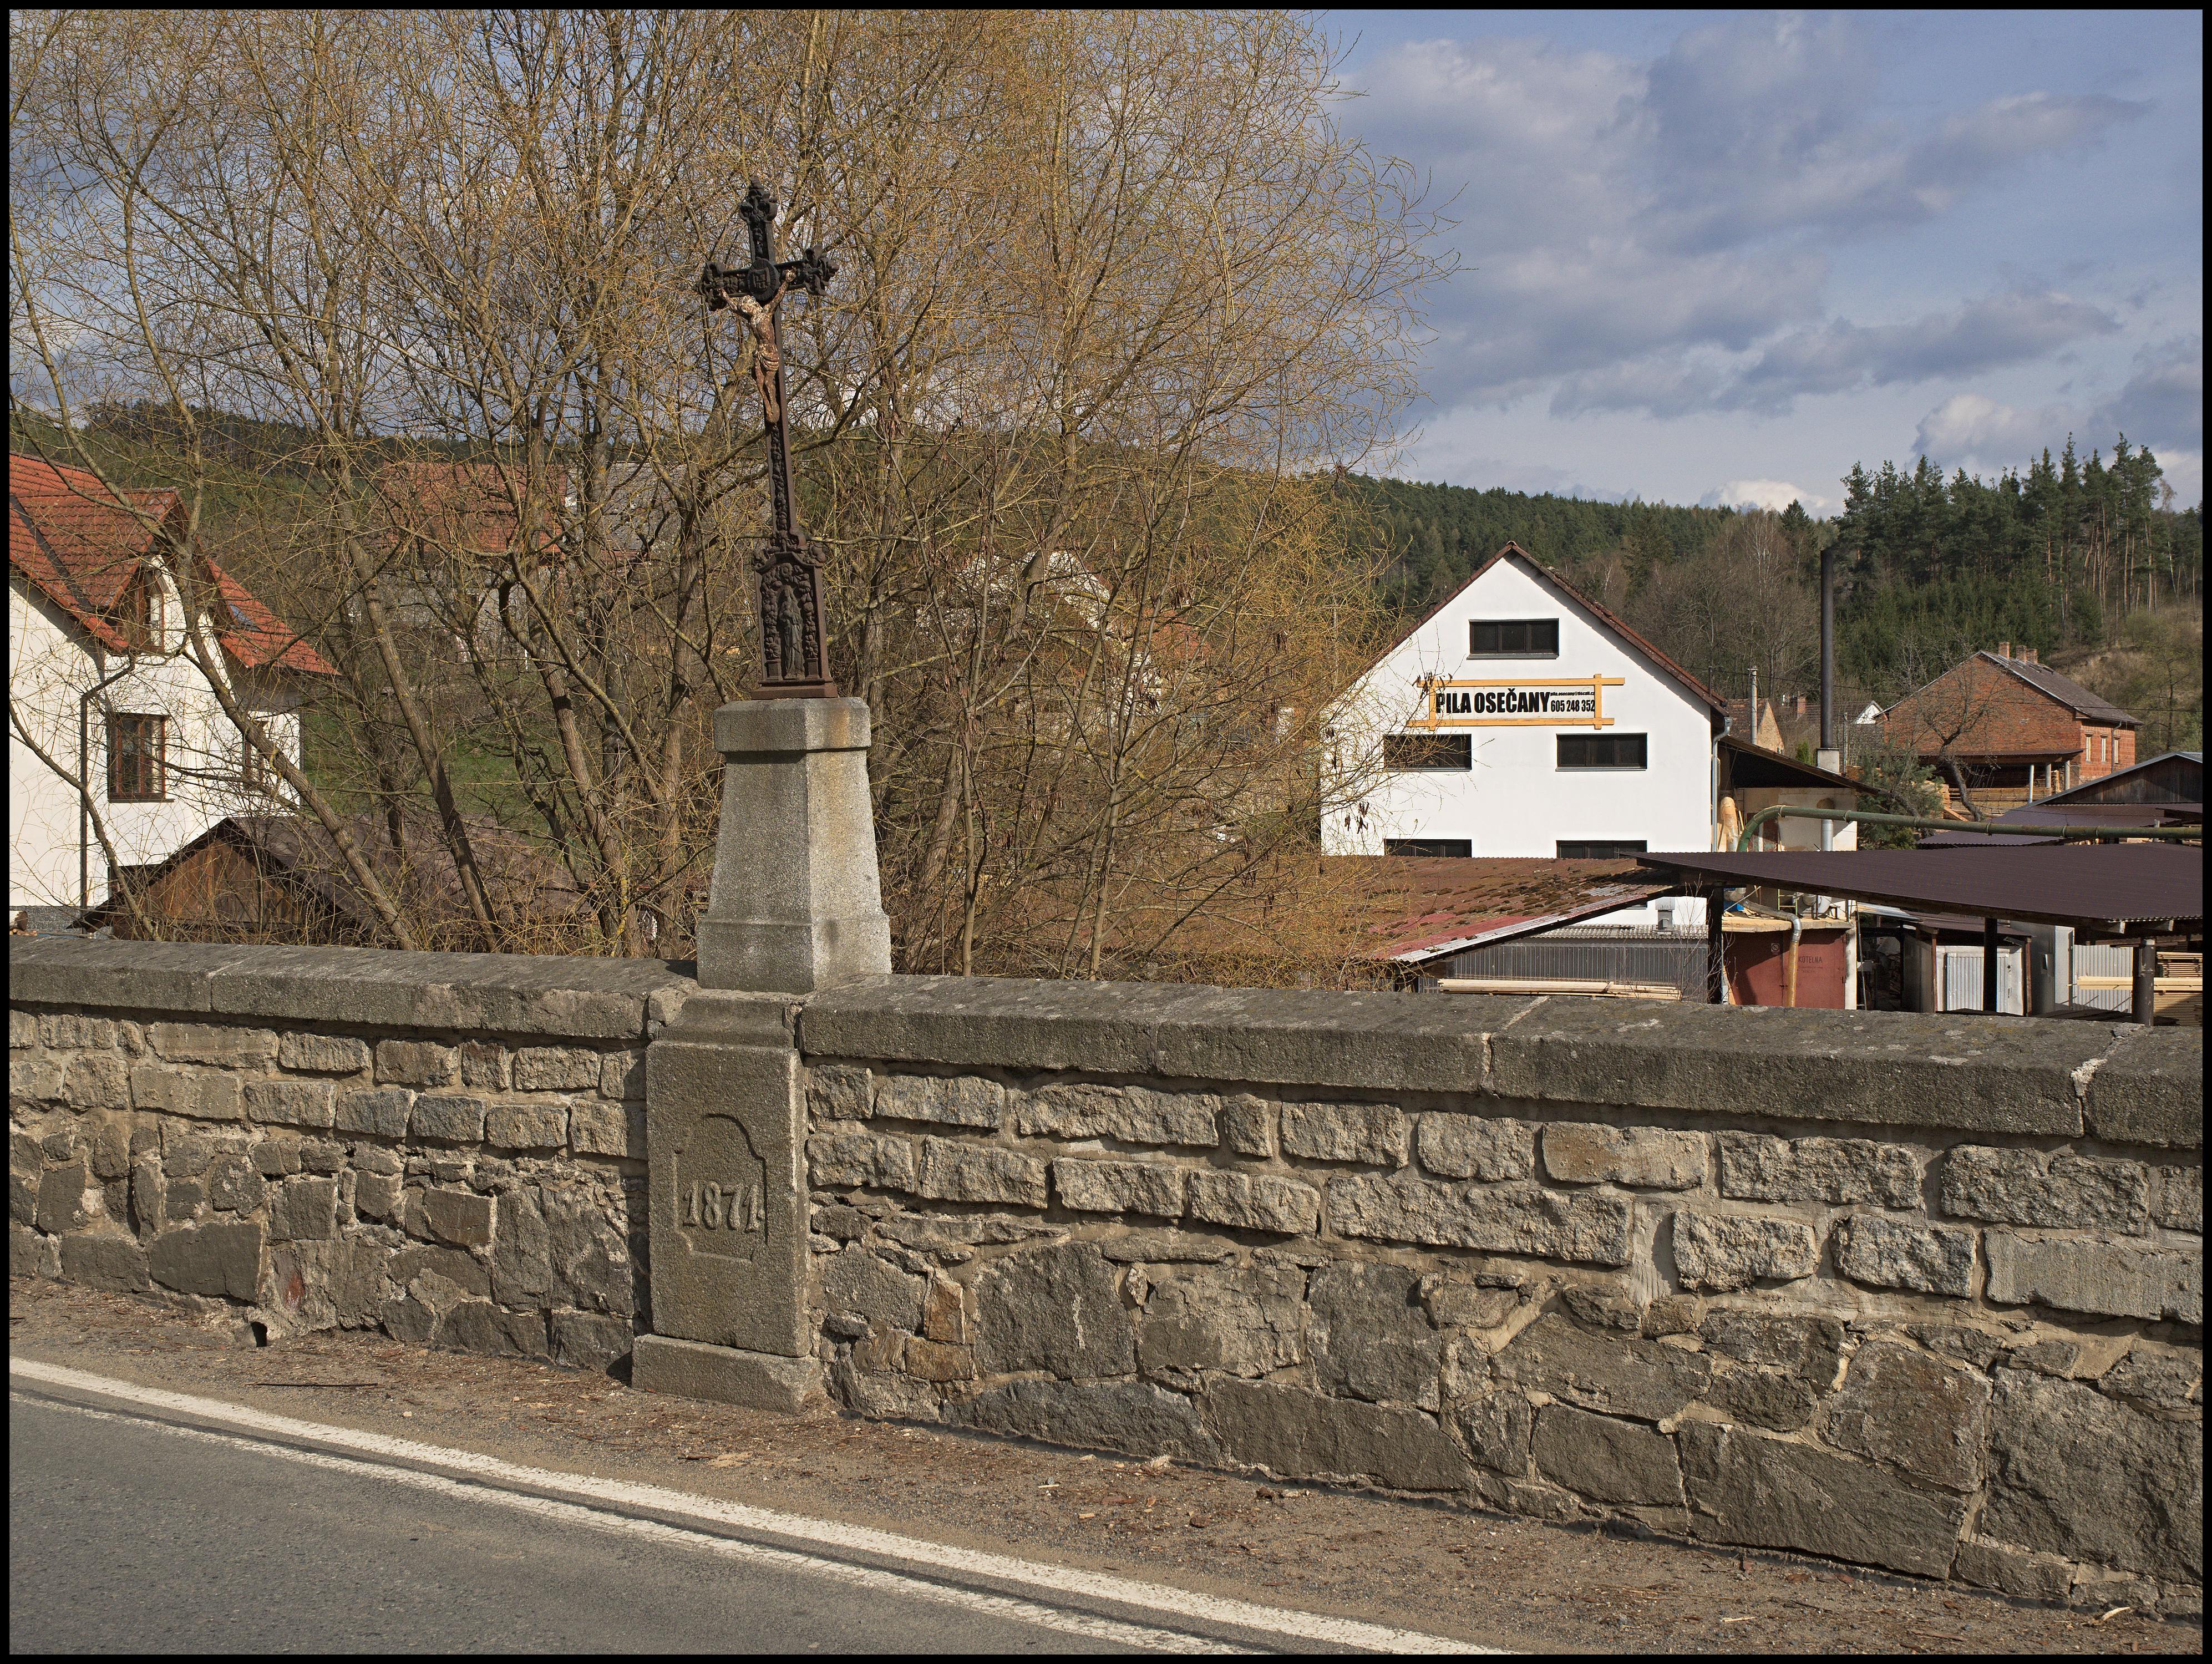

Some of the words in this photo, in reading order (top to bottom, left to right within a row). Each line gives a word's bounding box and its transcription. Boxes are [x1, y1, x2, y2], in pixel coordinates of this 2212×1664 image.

[1435, 692, 1472, 713] PILA
[1474, 688, 1550, 713] OSEČANY
[1551, 699, 1565, 712] 605
[1566, 699, 1580, 712] 248
[1581, 699, 1595, 712] 352
